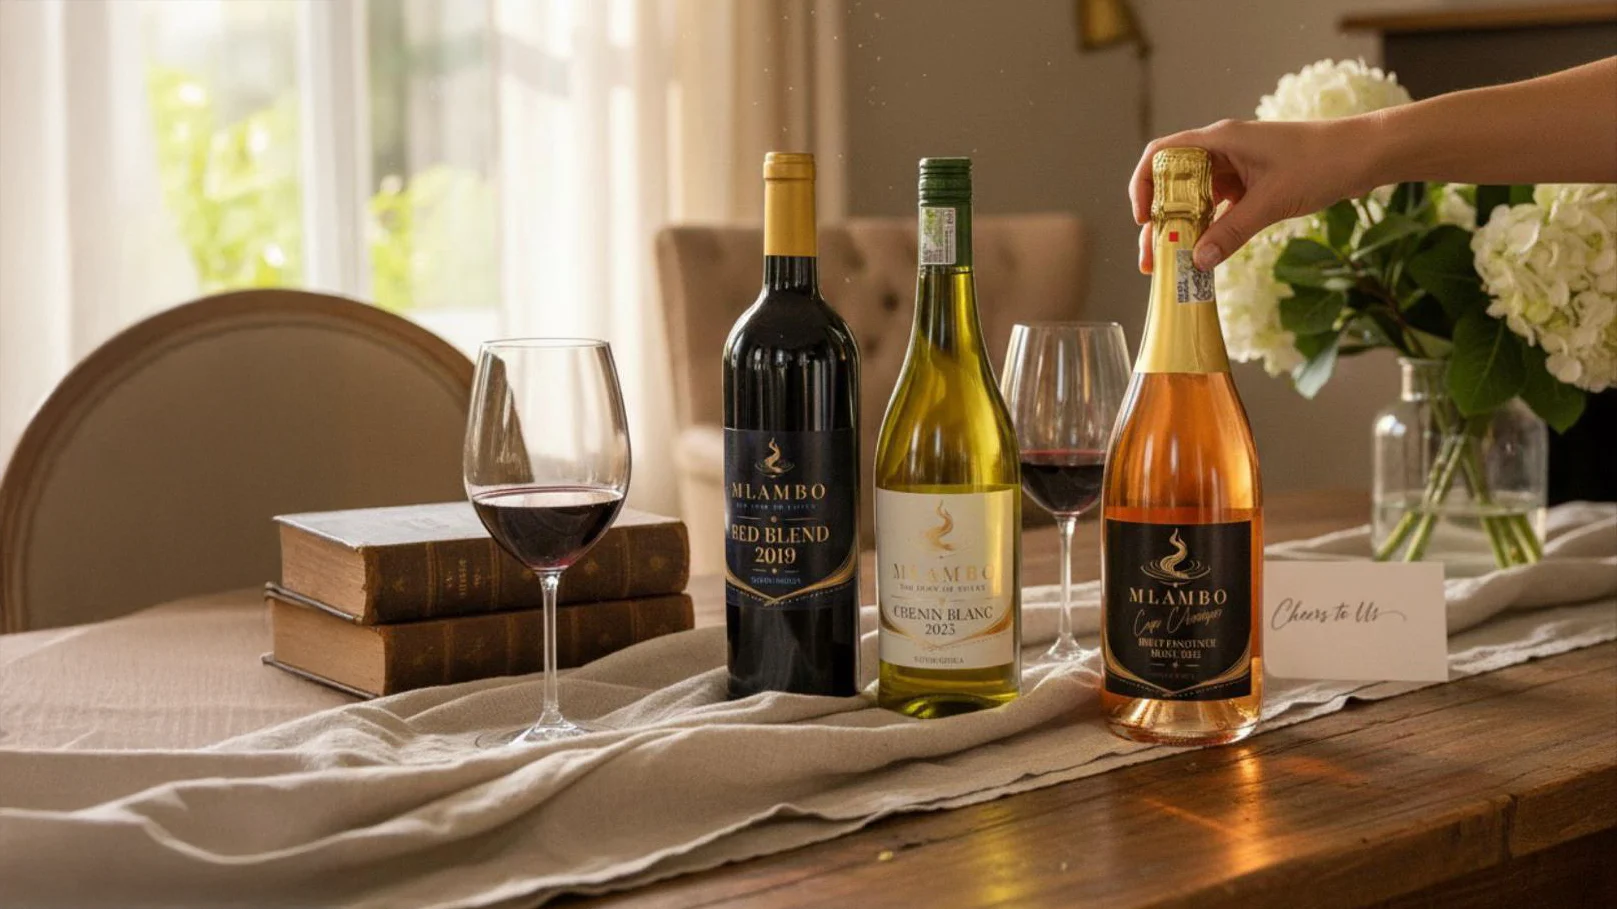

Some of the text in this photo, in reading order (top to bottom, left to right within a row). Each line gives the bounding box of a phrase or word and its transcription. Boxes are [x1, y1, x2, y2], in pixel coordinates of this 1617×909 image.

[731, 482, 826, 501] MLAMBO
[765, 525, 830, 544] BLEND
[755, 546, 796, 565] 2019
[893, 563, 995, 583] MLAMBO
[1129, 587, 1228, 606] MLAMBO
[948, 605, 993, 621] BLANC
[1271, 597, 1328, 631] Cheers
[1332, 602, 1351, 621] to
